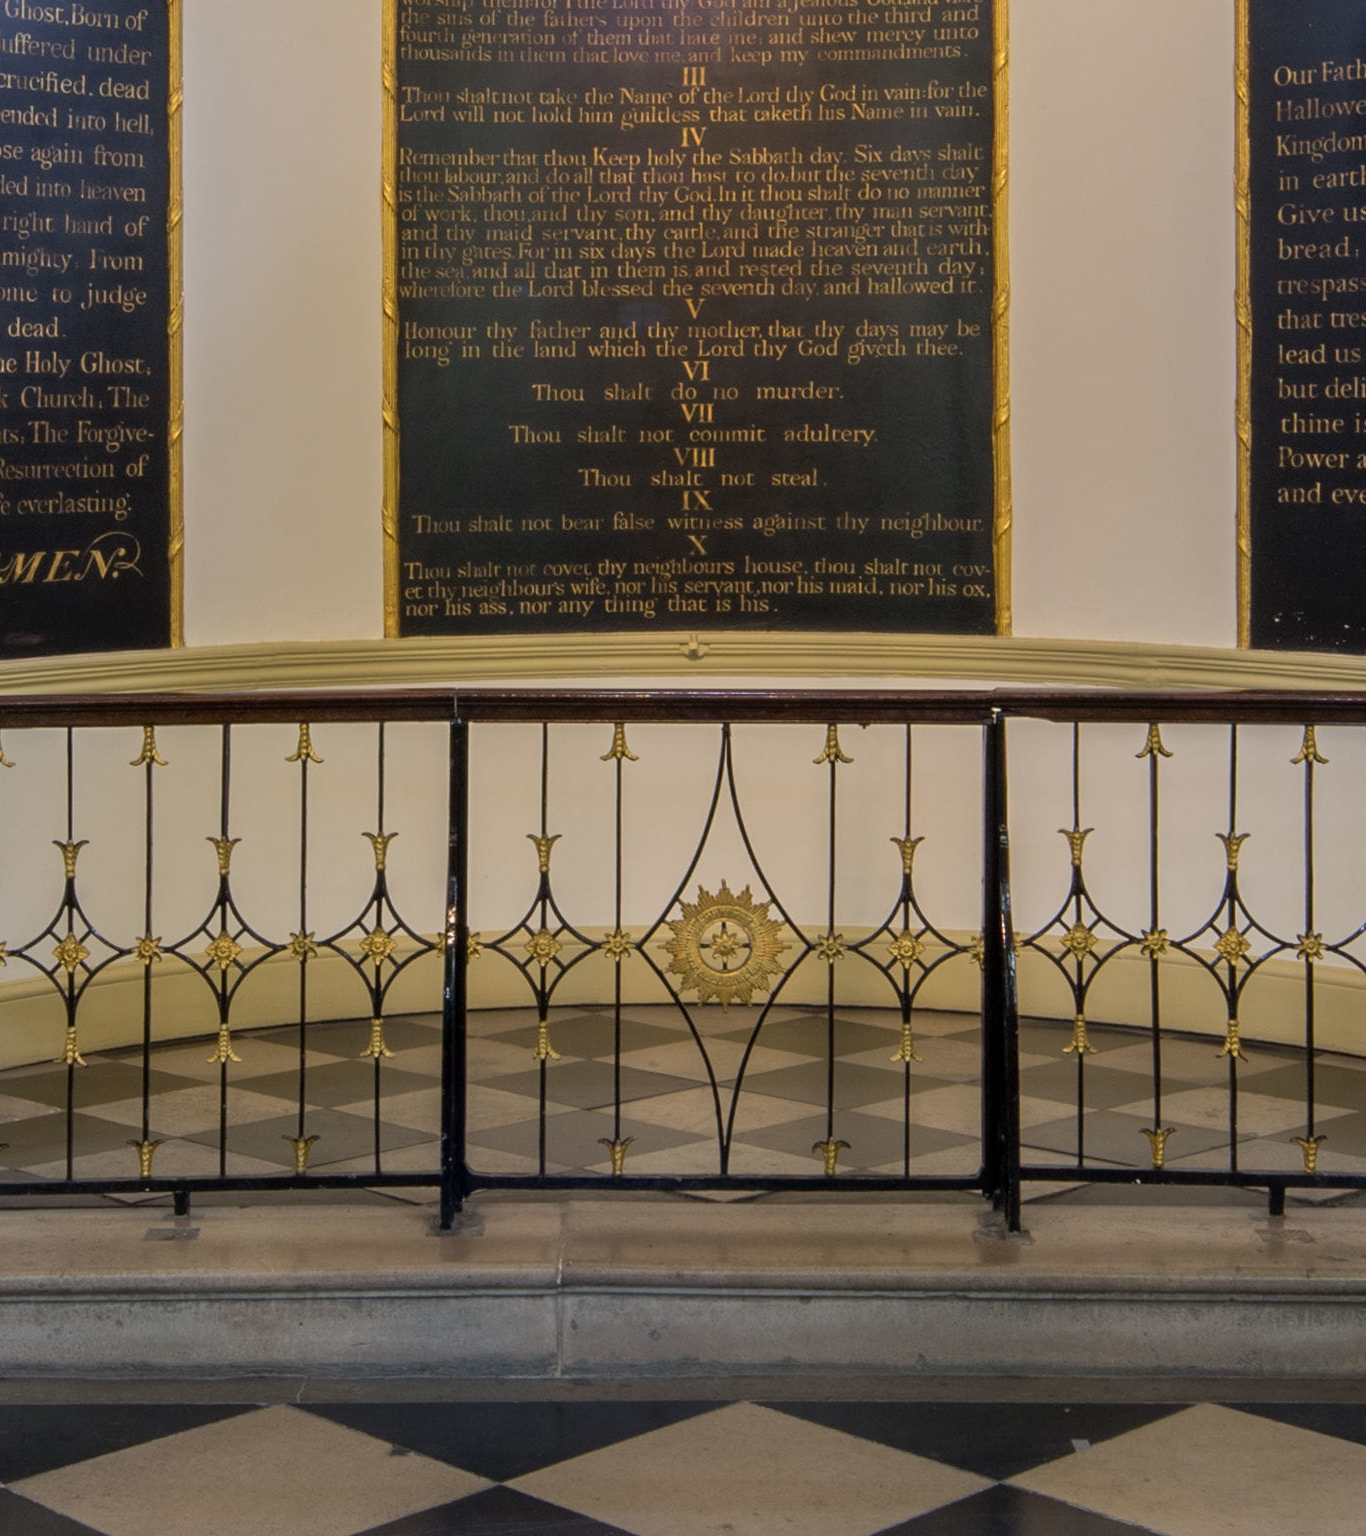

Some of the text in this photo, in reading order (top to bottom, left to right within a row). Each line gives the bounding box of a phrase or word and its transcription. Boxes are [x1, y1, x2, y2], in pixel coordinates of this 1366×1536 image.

[88, 44, 152, 66] under
[682, 66, 706, 86] III
[1274, 66, 1317, 86] Our
[681, 127, 707, 147] IV
[1279, 170, 1299, 191] in
[1277, 204, 1334, 225] Give
[684, 298, 706, 319] V
[7, 316, 66, 338] dead.
[1277, 309, 1322, 330] that
[25, 351, 71, 378] Holy
[1278, 344, 1327, 364] lead
[1334, 348, 1361, 363] us
[681, 360, 710, 381] VI
[531, 381, 843, 402] Thou shalt do no murder.
[1278, 377, 1318, 399] but
[680, 403, 714, 423] VII
[1281, 412, 1344, 434] thine
[508, 424, 561, 444] Thou
[577, 425, 626, 443] shalt
[639, 429, 674, 443] not
[689, 424, 766, 442] commit
[673, 447, 715, 468] VIII
[1278, 446, 1350, 469] Power
[577, 468, 631, 487] Thou
[651, 470, 703, 486] shalt
[721, 473, 755, 486] not
[681, 490, 713, 511] IX
[1278, 481, 1323, 504] and
[411, 515, 460, 534] Thou
[468, 515, 513, 532] shalt
[522, 518, 553, 531] not
[562, 514, 604, 531] bear
[613, 511, 655, 530] false
[667, 513, 743, 530] witness
[752, 512, 826, 537] against
[836, 512, 870, 534] thy
[687, 535, 707, 555] X
